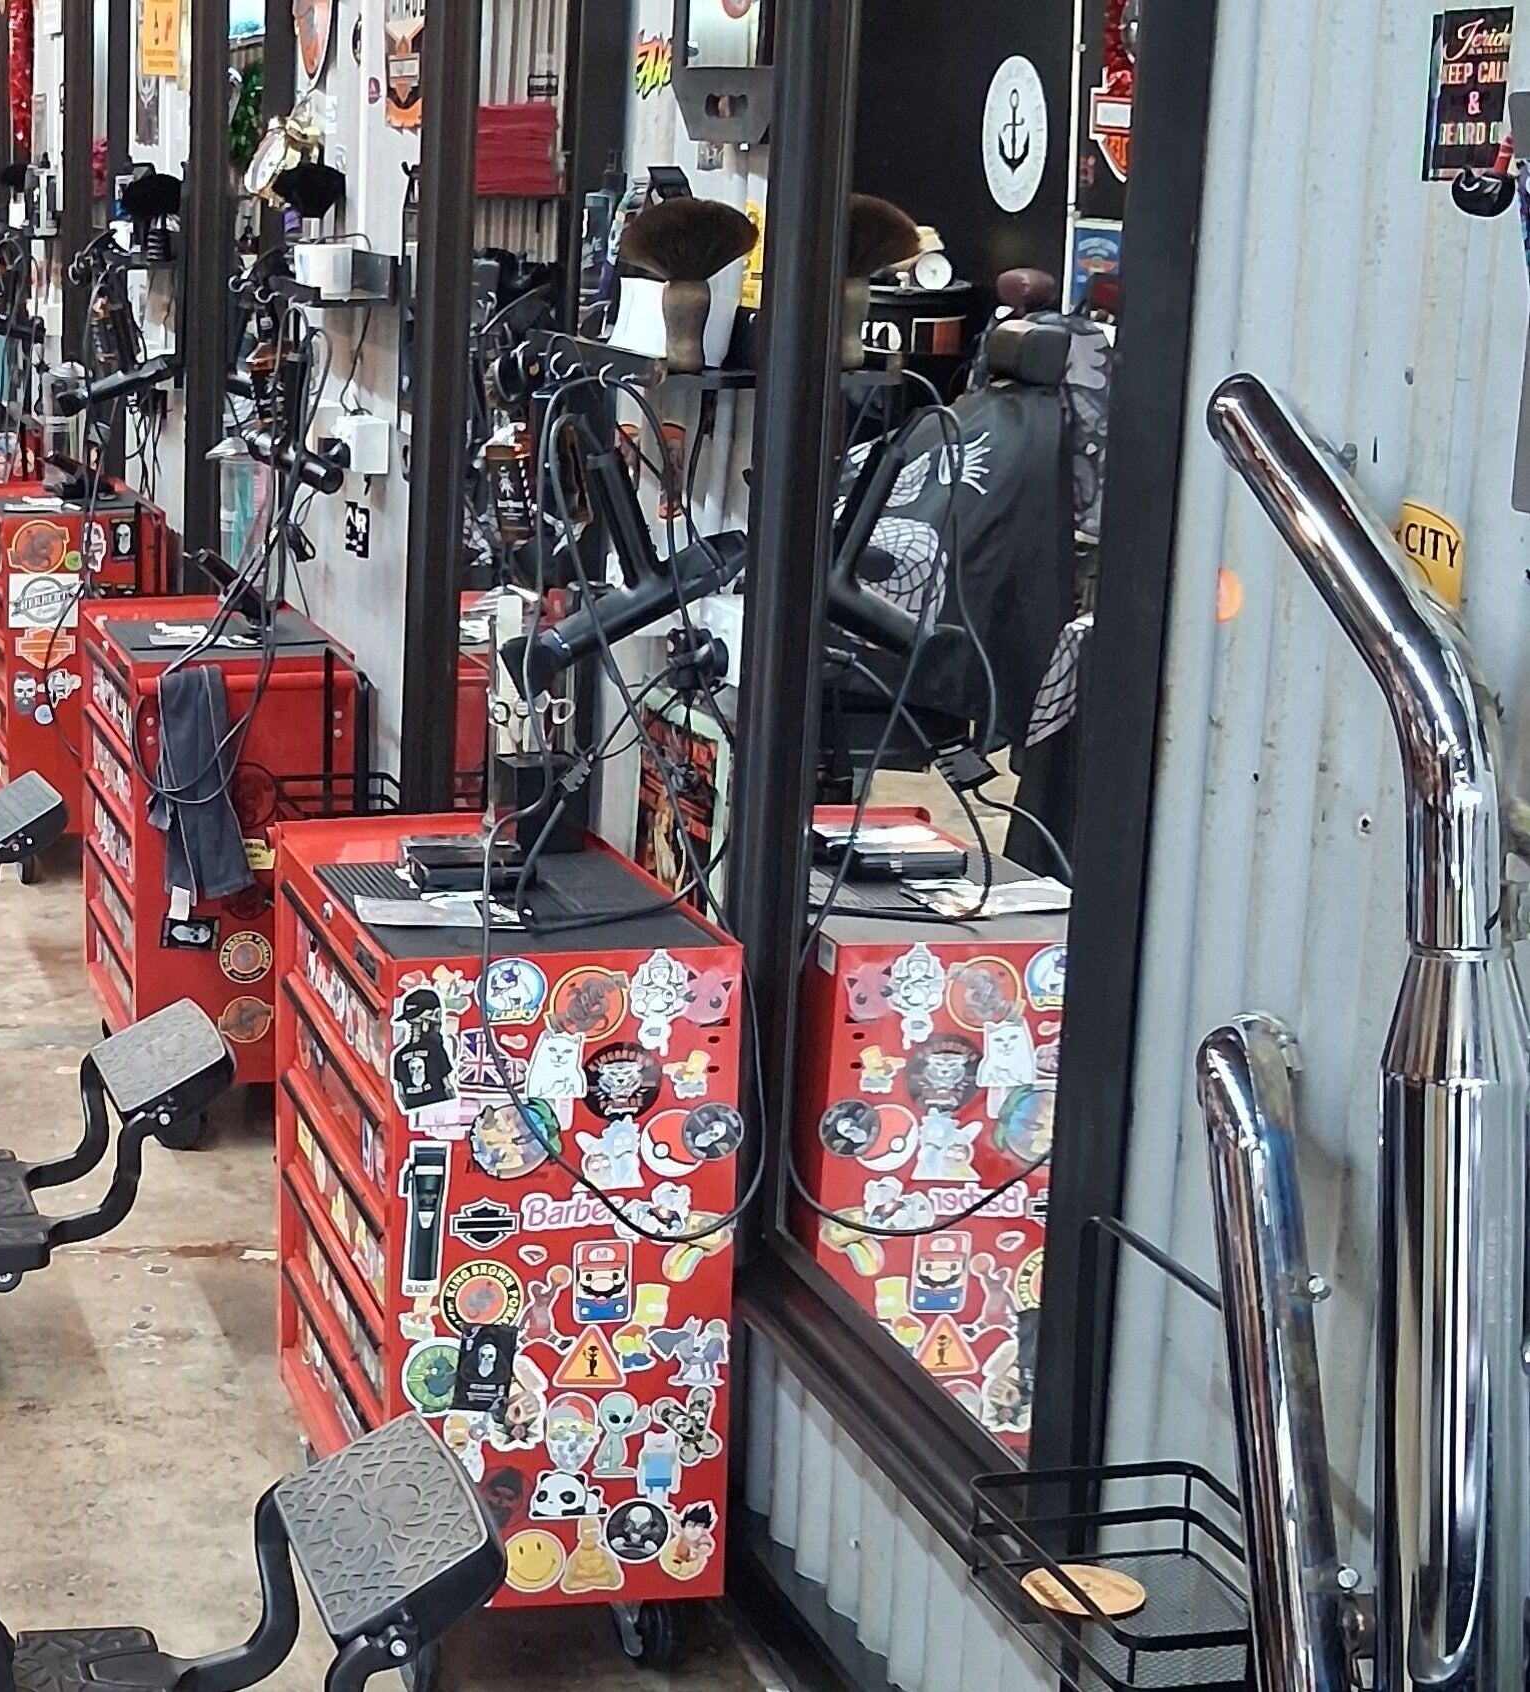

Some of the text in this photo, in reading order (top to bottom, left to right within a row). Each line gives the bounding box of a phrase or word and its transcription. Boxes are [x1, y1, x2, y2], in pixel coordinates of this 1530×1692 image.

[1441, 63, 1474, 85] KEEP
[1467, 91, 1481, 115] &
[1405, 522, 1461, 568] CITY
[525, 1197, 614, 1227] Barber
[445, 1269, 471, 1298] KING
[470, 1264, 515, 1288] BROWN
